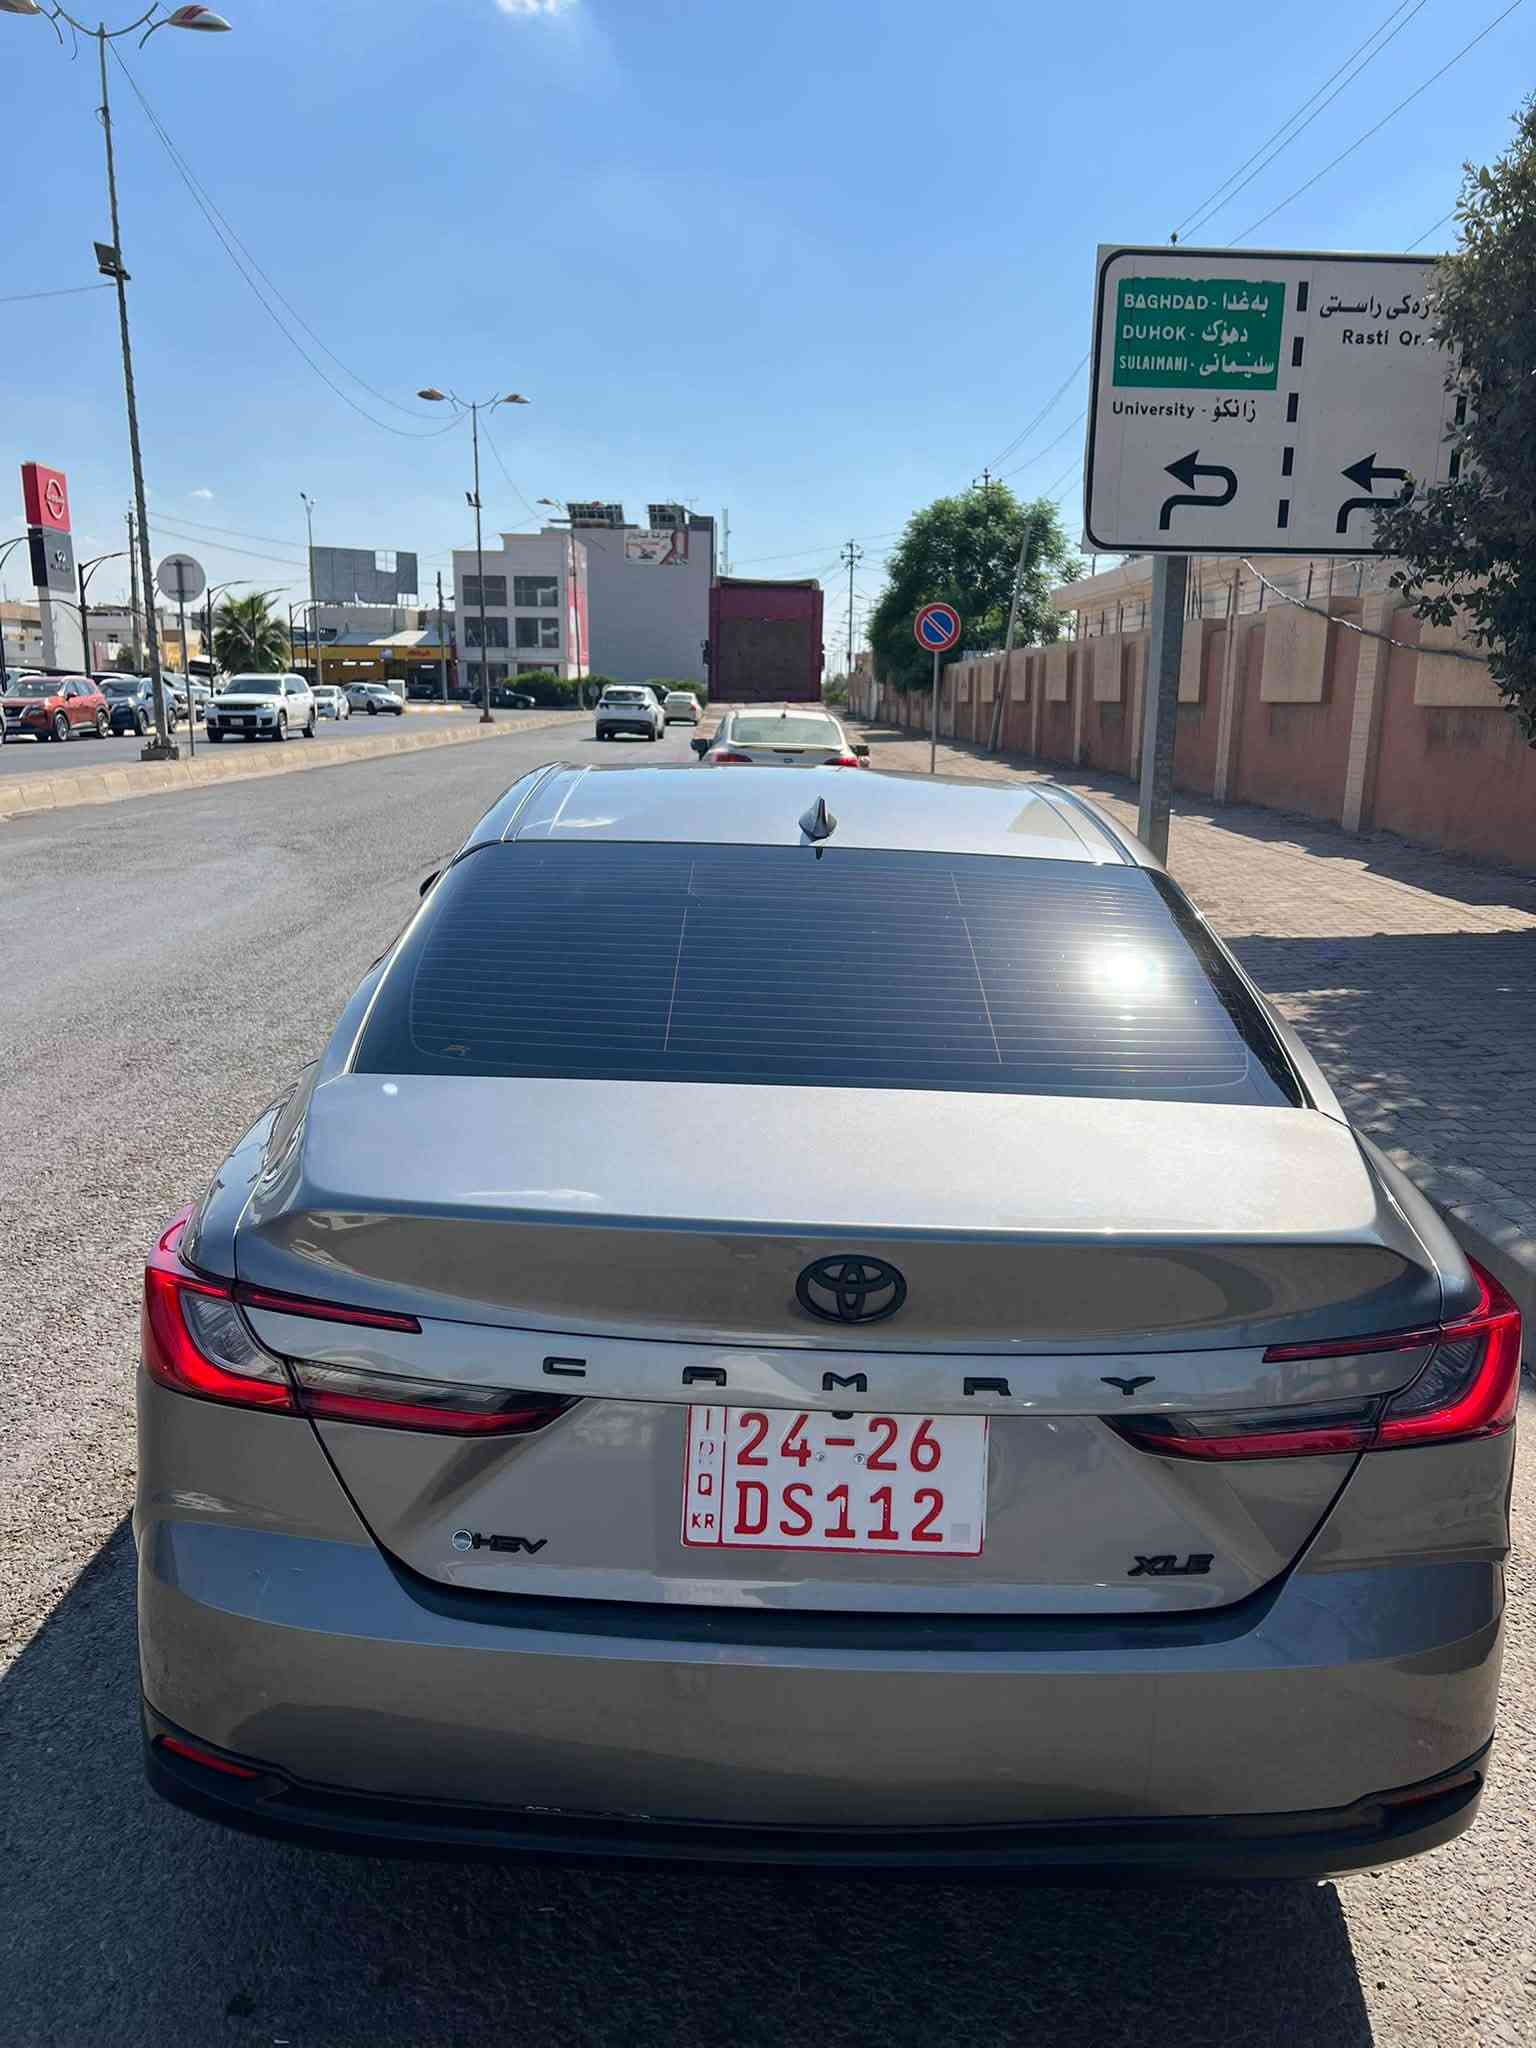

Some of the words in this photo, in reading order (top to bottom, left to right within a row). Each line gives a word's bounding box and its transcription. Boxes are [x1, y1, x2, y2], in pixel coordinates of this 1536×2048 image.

[1123, 293, 1209, 310] BAGHDAD
[1122, 324, 1187, 341] DUHOK
[1342, 329, 1389, 345] Rasti
[1400, 330, 1425, 346] Qr.
[1119, 355, 1188, 372] SULAIMANI
[1112, 401, 1195, 419] University
[542, 1356, 1157, 1396] CAMRY
[736, 1412, 941, 1473] 24-26
[734, 1480, 944, 1542] DS112
[691, 1513, 714, 1529] KR
[472, 1533, 548, 1554] HEV
[1127, 1553, 1215, 1577] XLE
